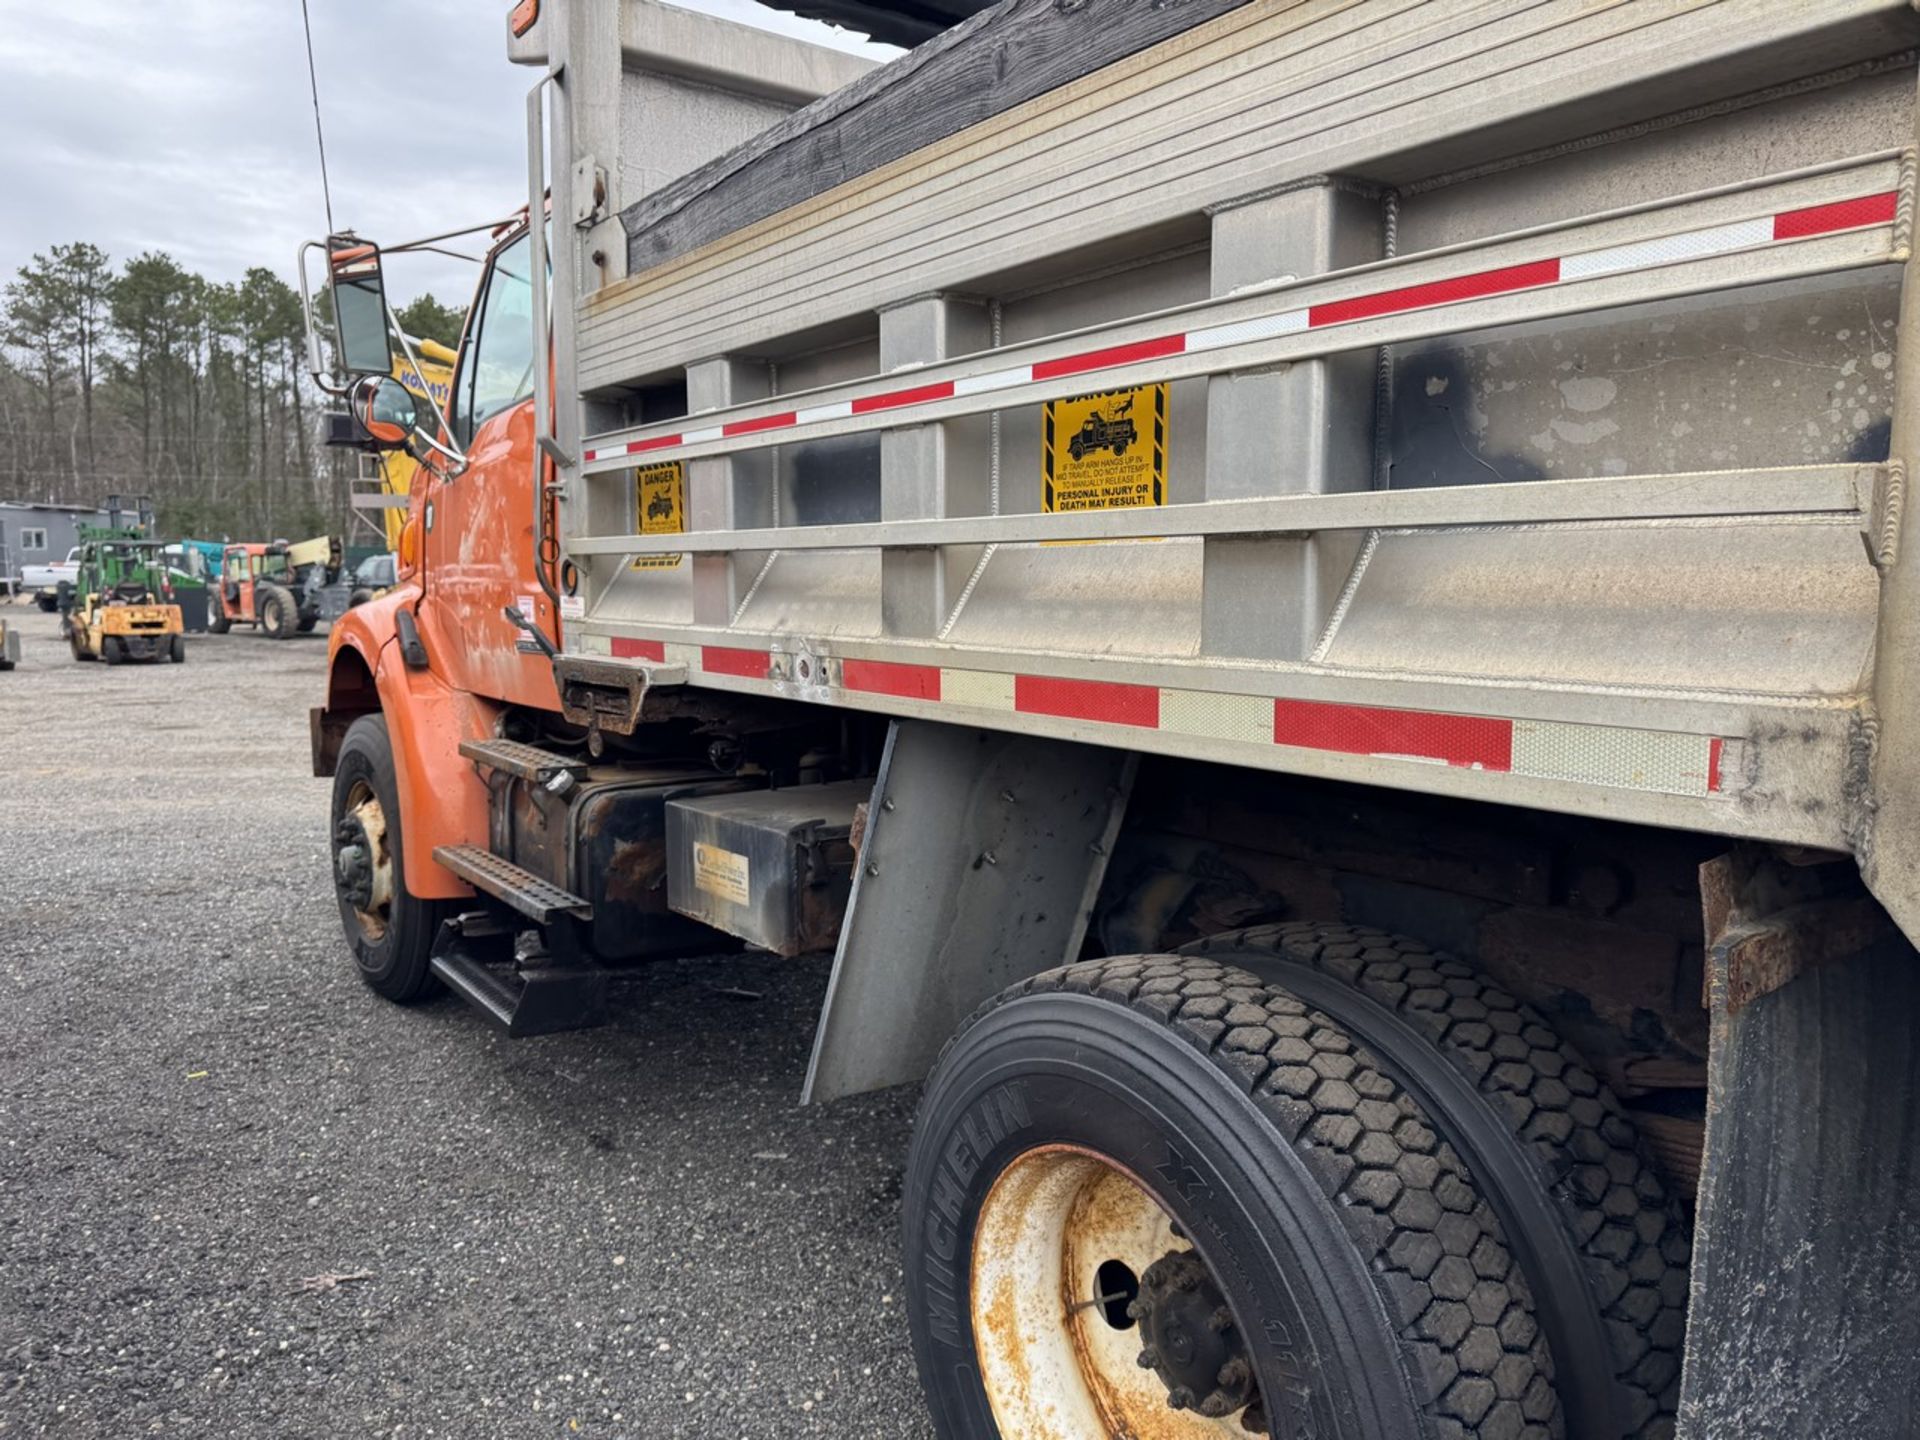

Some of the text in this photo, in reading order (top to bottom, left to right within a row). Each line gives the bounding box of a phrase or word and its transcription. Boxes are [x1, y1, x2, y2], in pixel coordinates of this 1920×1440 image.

[1069, 461, 1084, 469] TARP
[1086, 460, 1099, 468] ARM
[1101, 457, 1123, 467] HANGS
[1124, 456, 1134, 464] UP
[1135, 455, 1143, 463] IN
[644, 470, 674, 485] DANGER
[1093, 468, 1104, 477] DO
[1105, 466, 1118, 475] NOT
[1119, 463, 1150, 473] ATTEMPT
[1063, 481, 1070, 489] TO
[1072, 478, 1103, 488] MANUALLY
[1105, 475, 1134, 485] RELEASE
[1057, 484, 1148, 500] PERSONAL INJURY OR
[1060, 495, 1145, 511] DEATH MAY RESULT!
[924, 1081, 1033, 1348] MICHELIN
